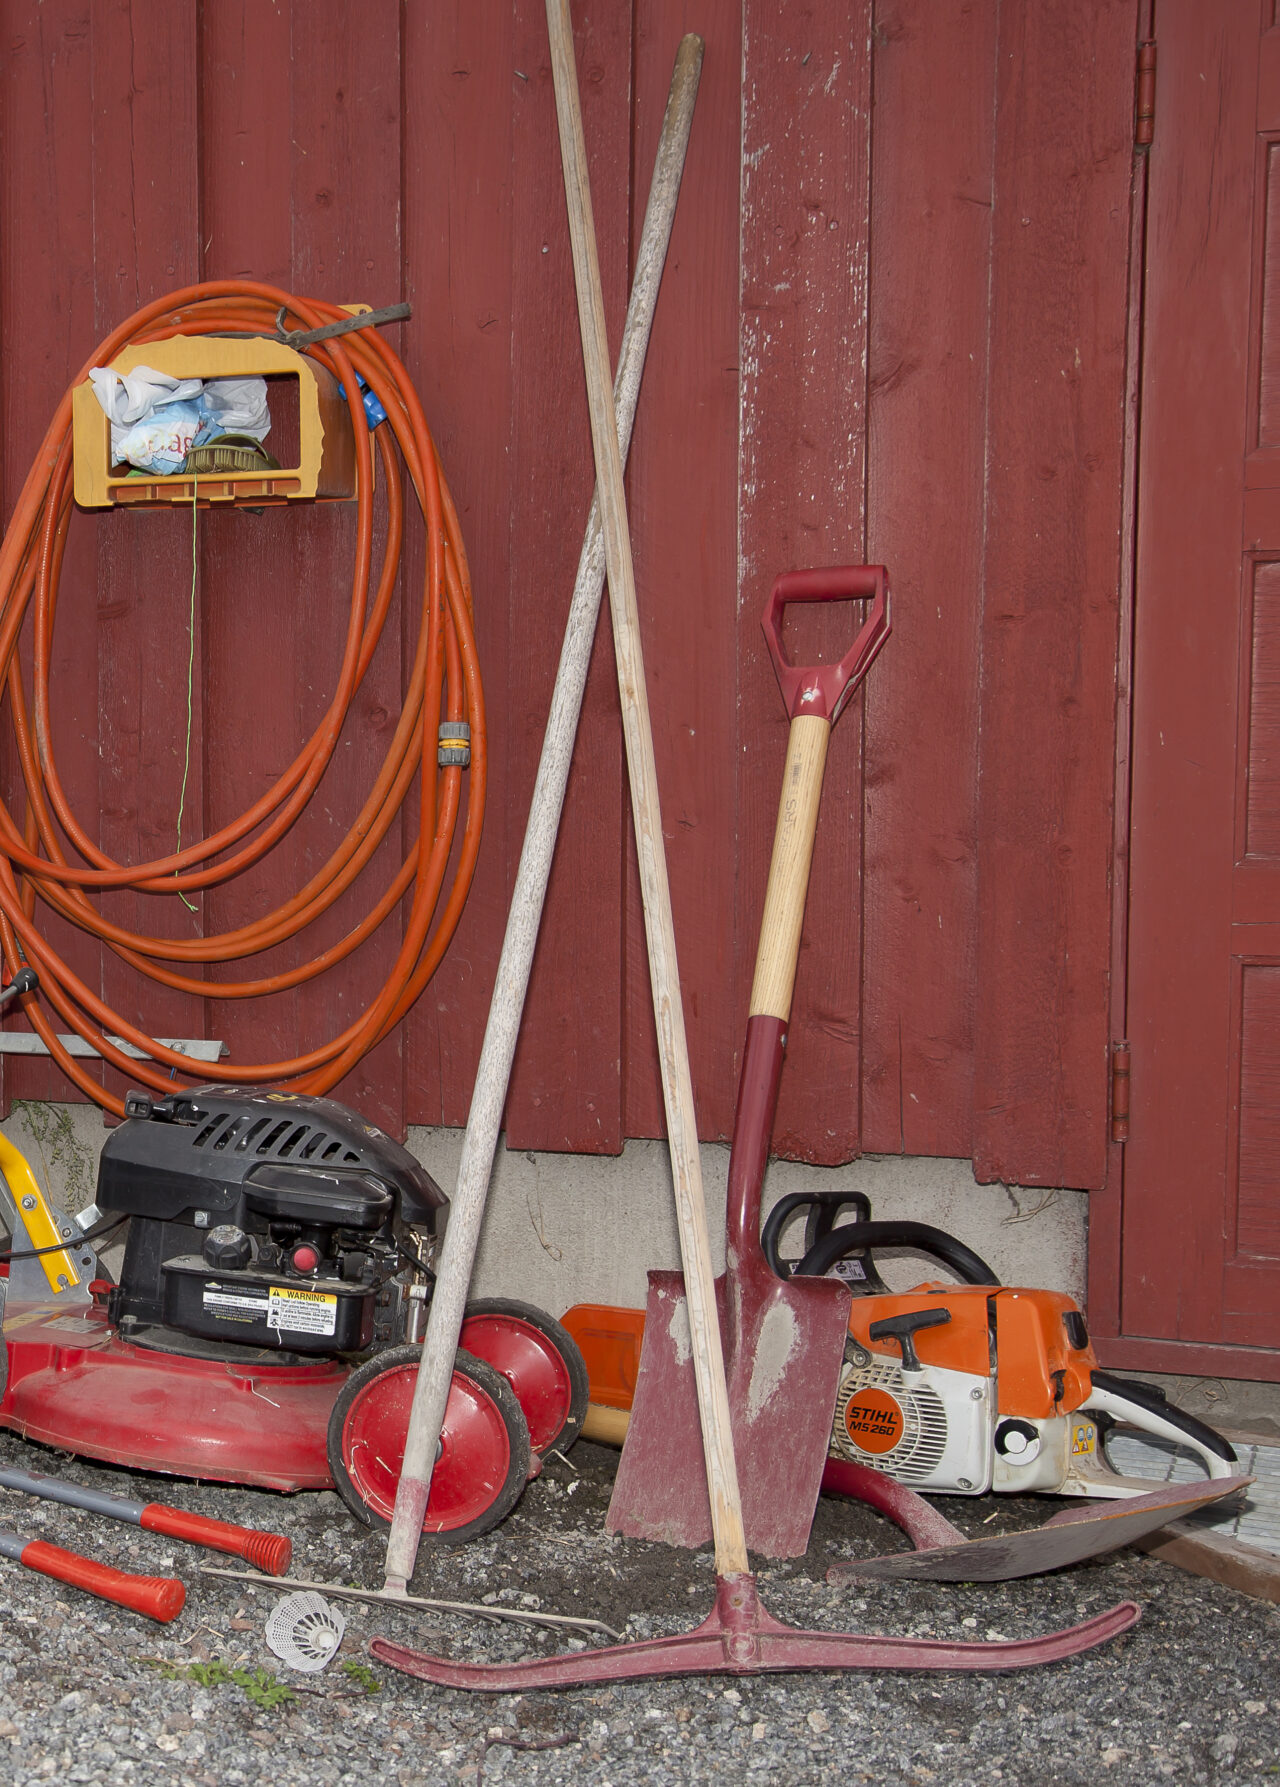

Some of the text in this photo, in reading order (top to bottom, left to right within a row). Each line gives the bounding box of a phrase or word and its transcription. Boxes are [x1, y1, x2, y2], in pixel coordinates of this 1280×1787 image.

[287, 1290, 326, 1303] WARNING
[849, 1406, 898, 1425] STIHL
[849, 1421, 895, 1436] MS 260
